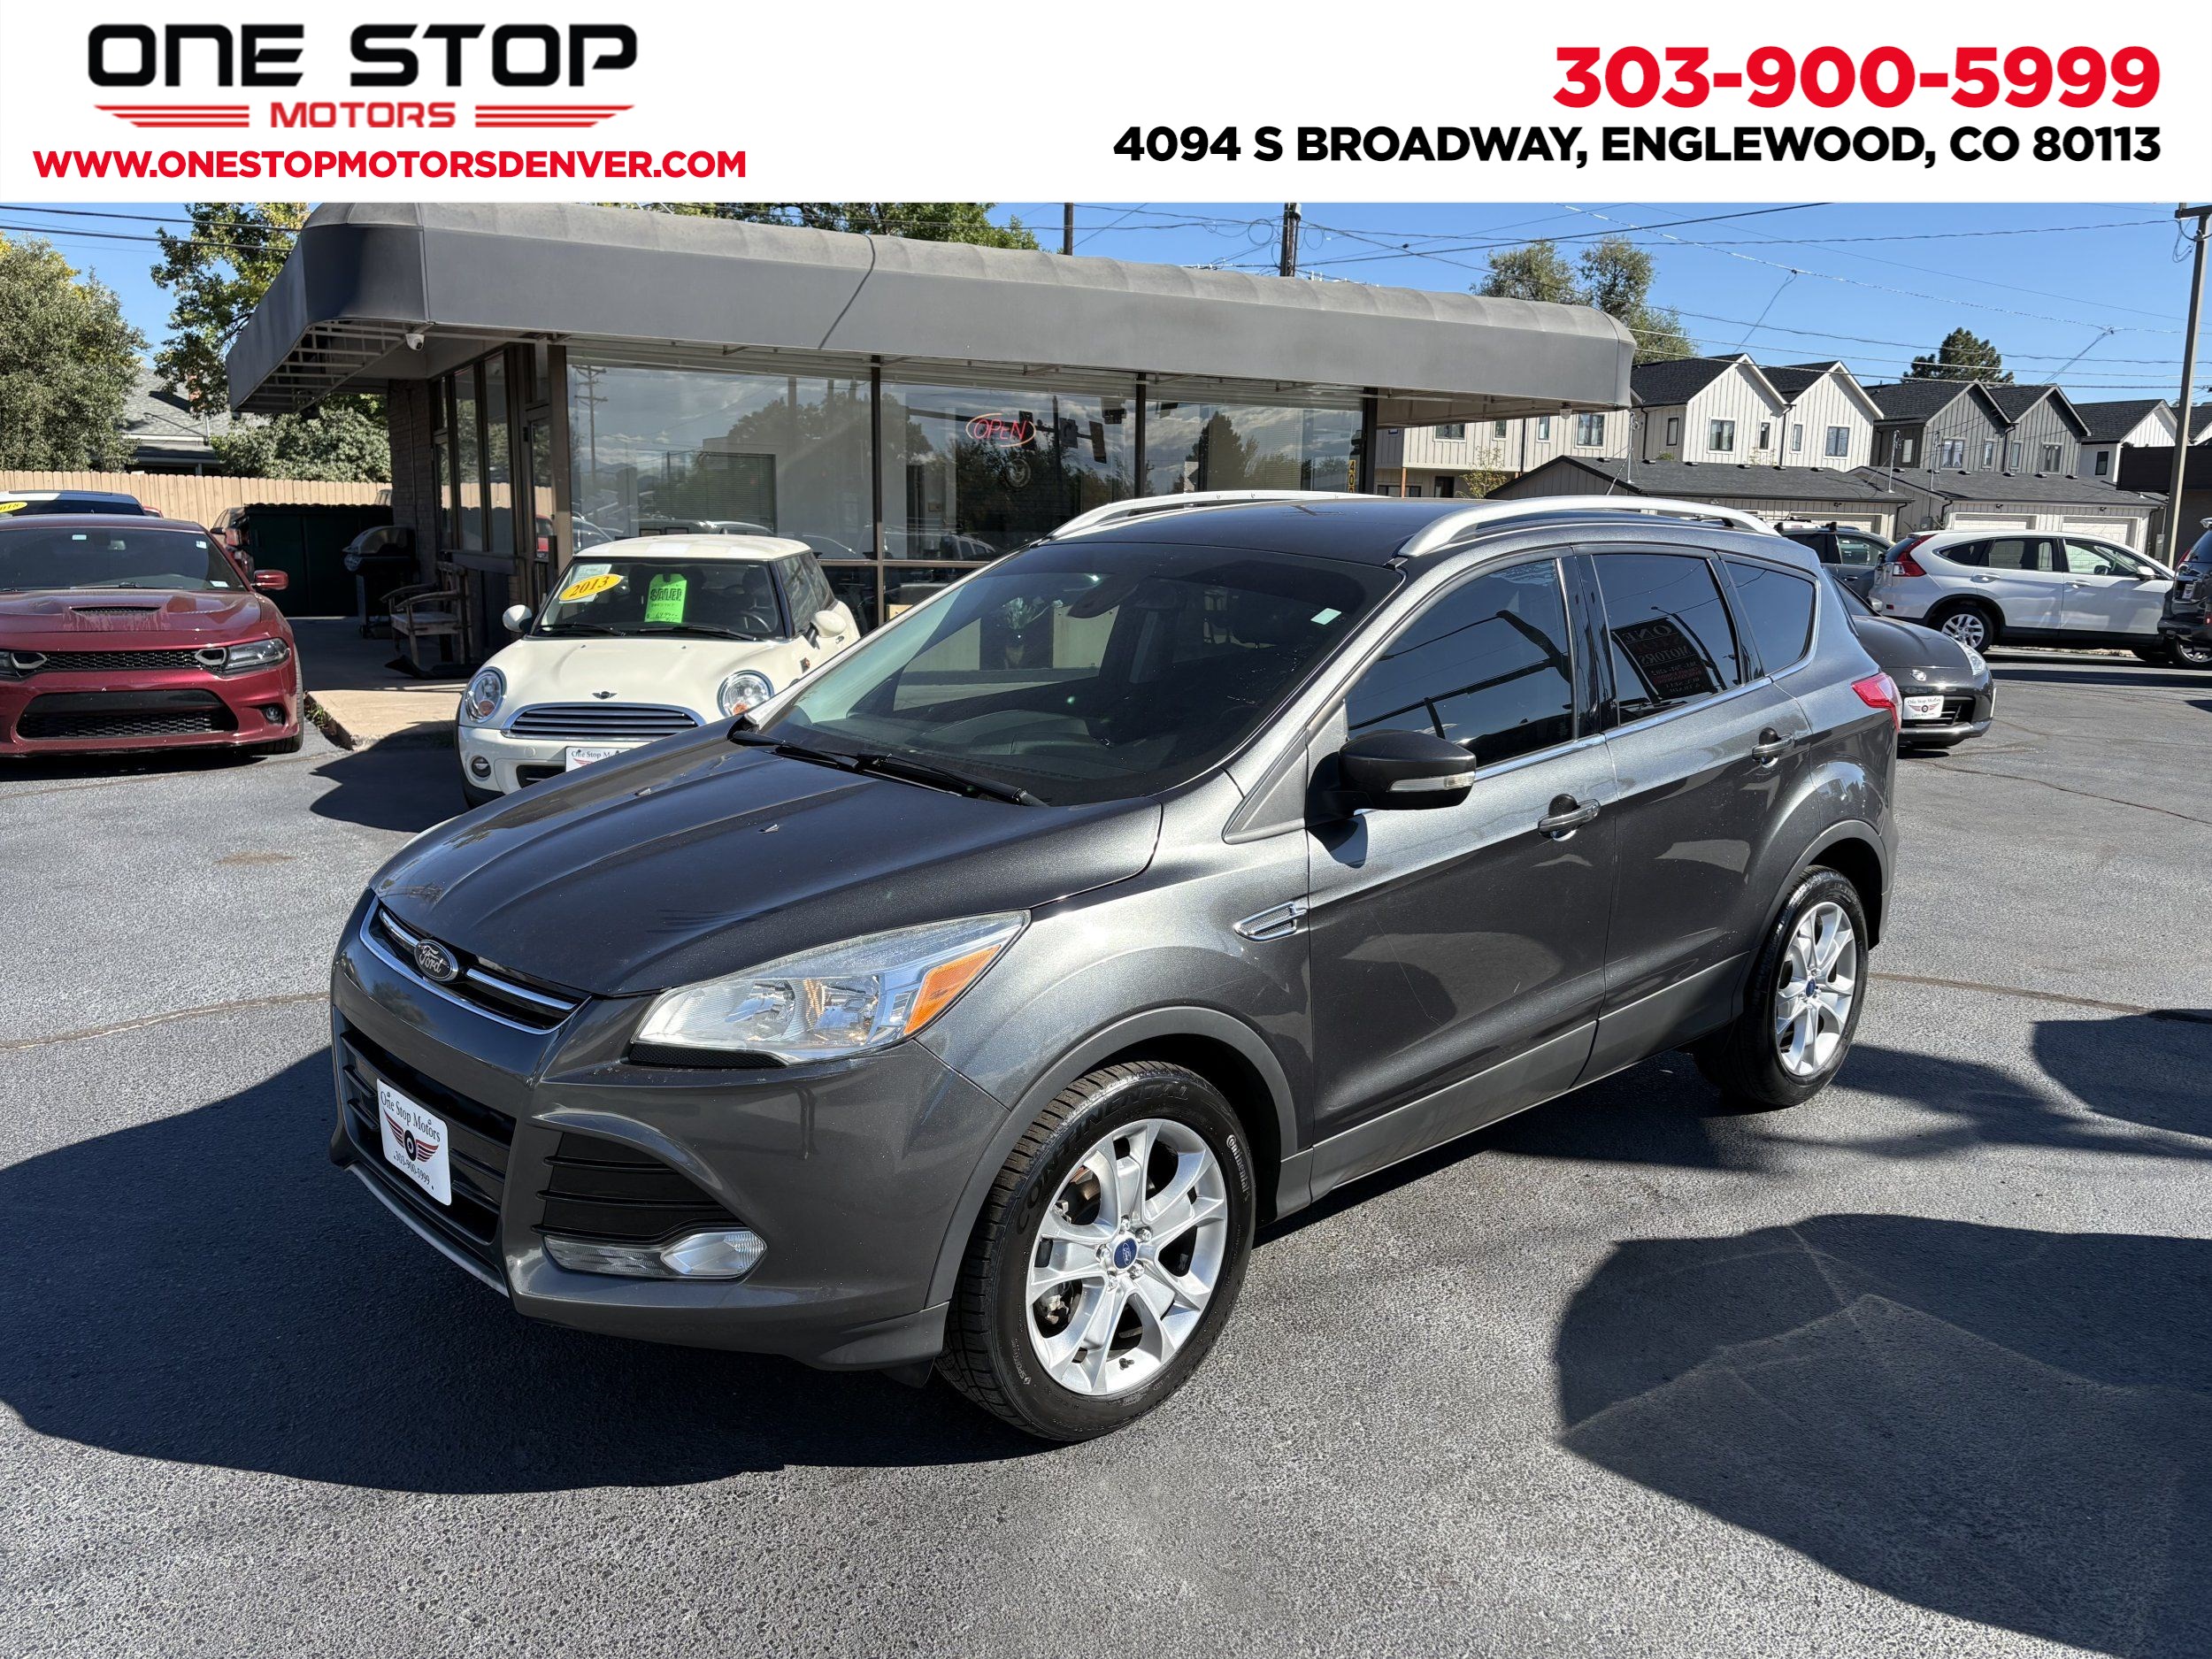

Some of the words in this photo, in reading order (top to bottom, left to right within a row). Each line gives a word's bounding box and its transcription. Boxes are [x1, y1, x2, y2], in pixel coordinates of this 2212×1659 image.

[974, 419, 1026, 440] OPEN
[569, 576, 610, 597] 2013
[419, 945, 448, 973] Ford
[380, 1091, 395, 1111] One
[396, 1101, 411, 1126] Stop
[413, 1112, 441, 1142] Motors
